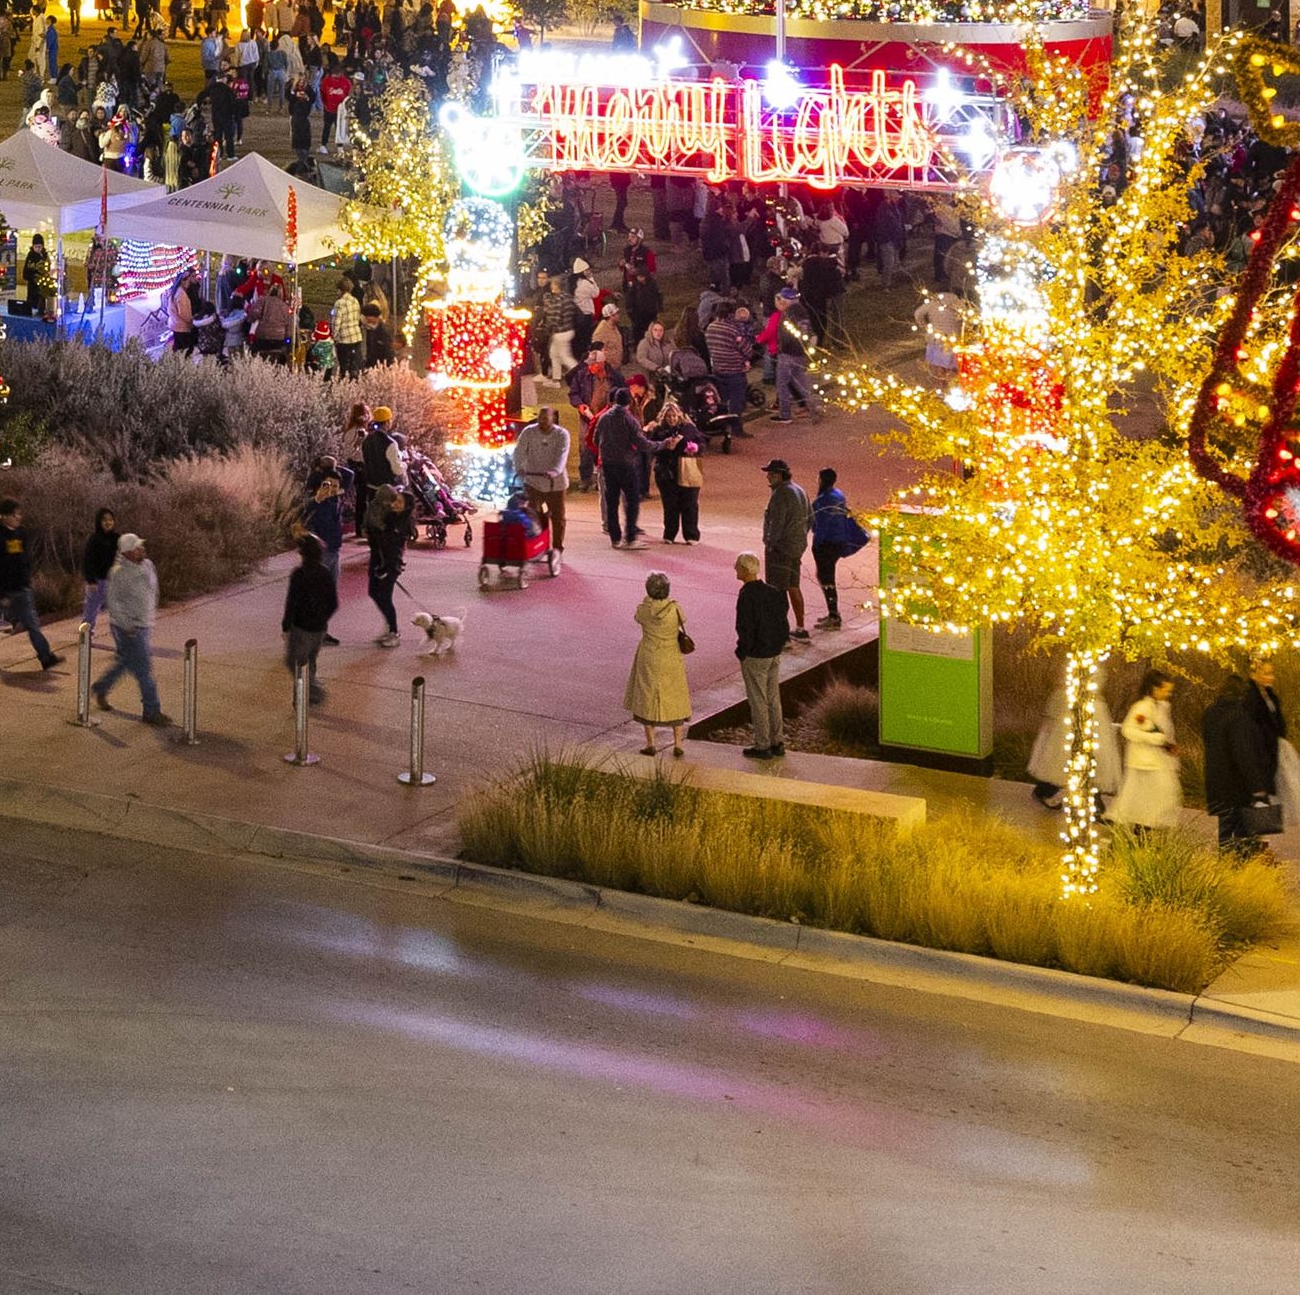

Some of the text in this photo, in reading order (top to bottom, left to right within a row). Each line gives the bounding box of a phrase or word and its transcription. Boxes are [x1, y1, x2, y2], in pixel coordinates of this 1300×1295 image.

[5, 178, 36, 190] PARK
[167, 197, 269, 217] CENTENNIAL PARK
